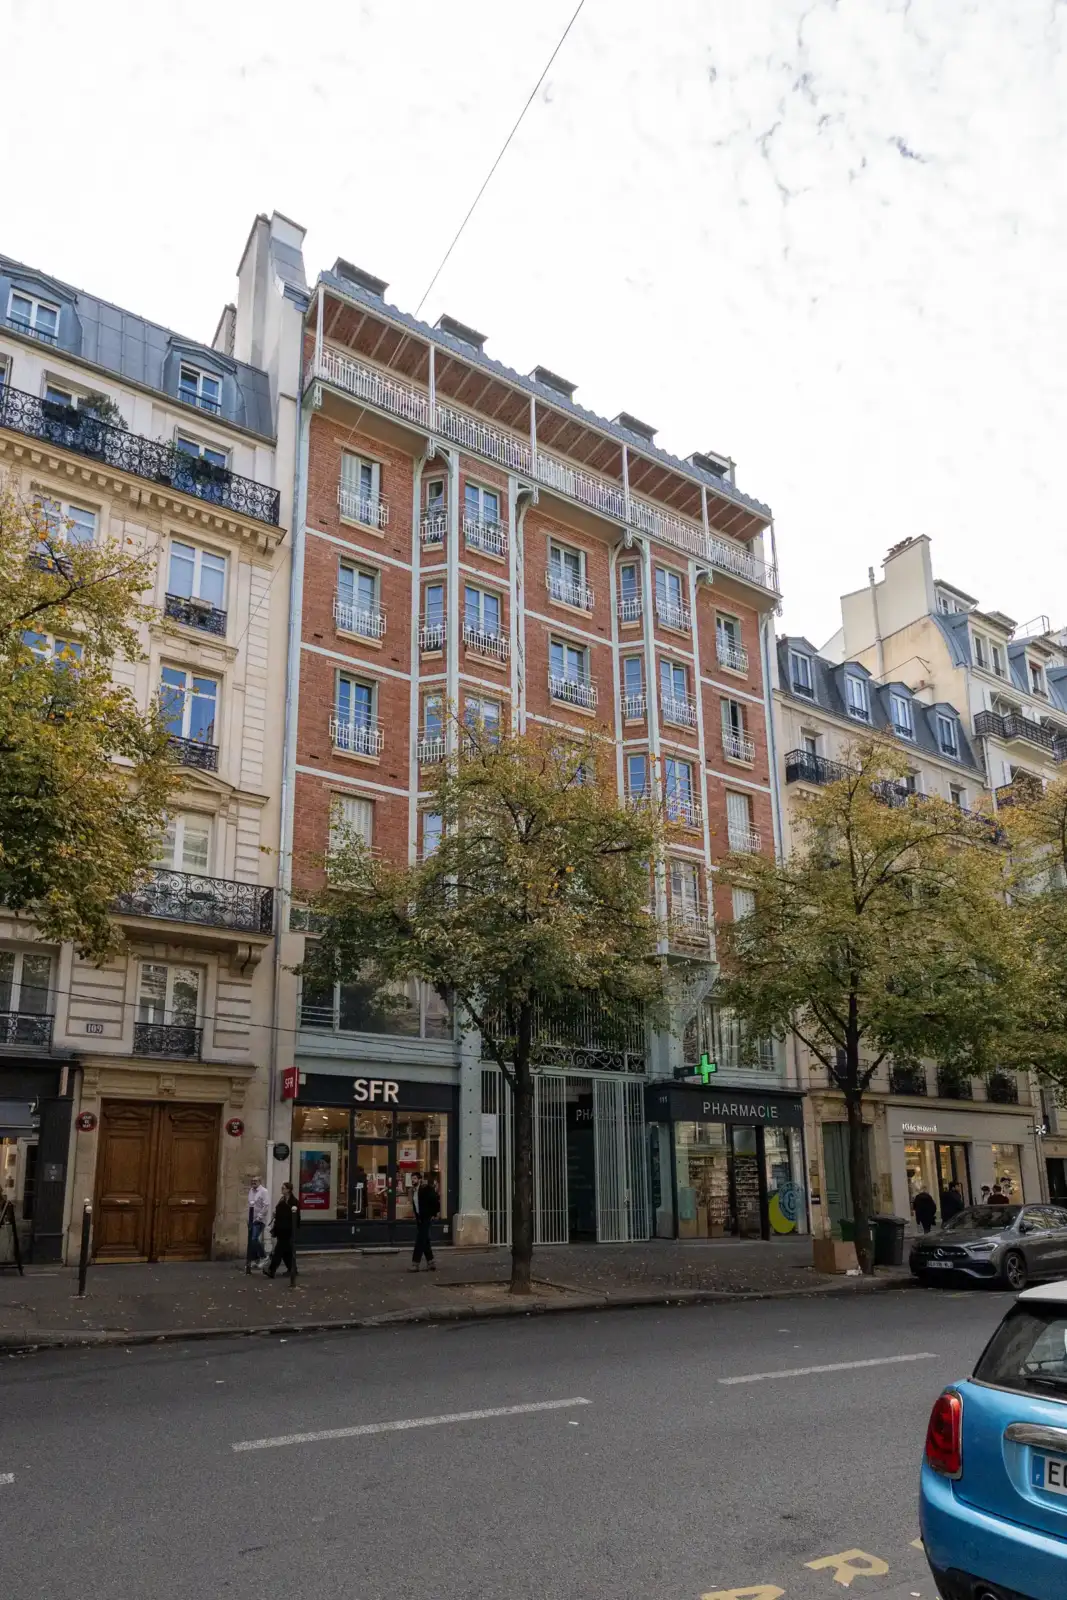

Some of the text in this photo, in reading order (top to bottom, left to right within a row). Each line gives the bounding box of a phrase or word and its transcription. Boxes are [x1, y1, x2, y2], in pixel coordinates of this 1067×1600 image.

[284, 1077, 294, 1089] SFR
[353, 1079, 399, 1103] SFR
[703, 1101, 779, 1119] PHARMACIE
